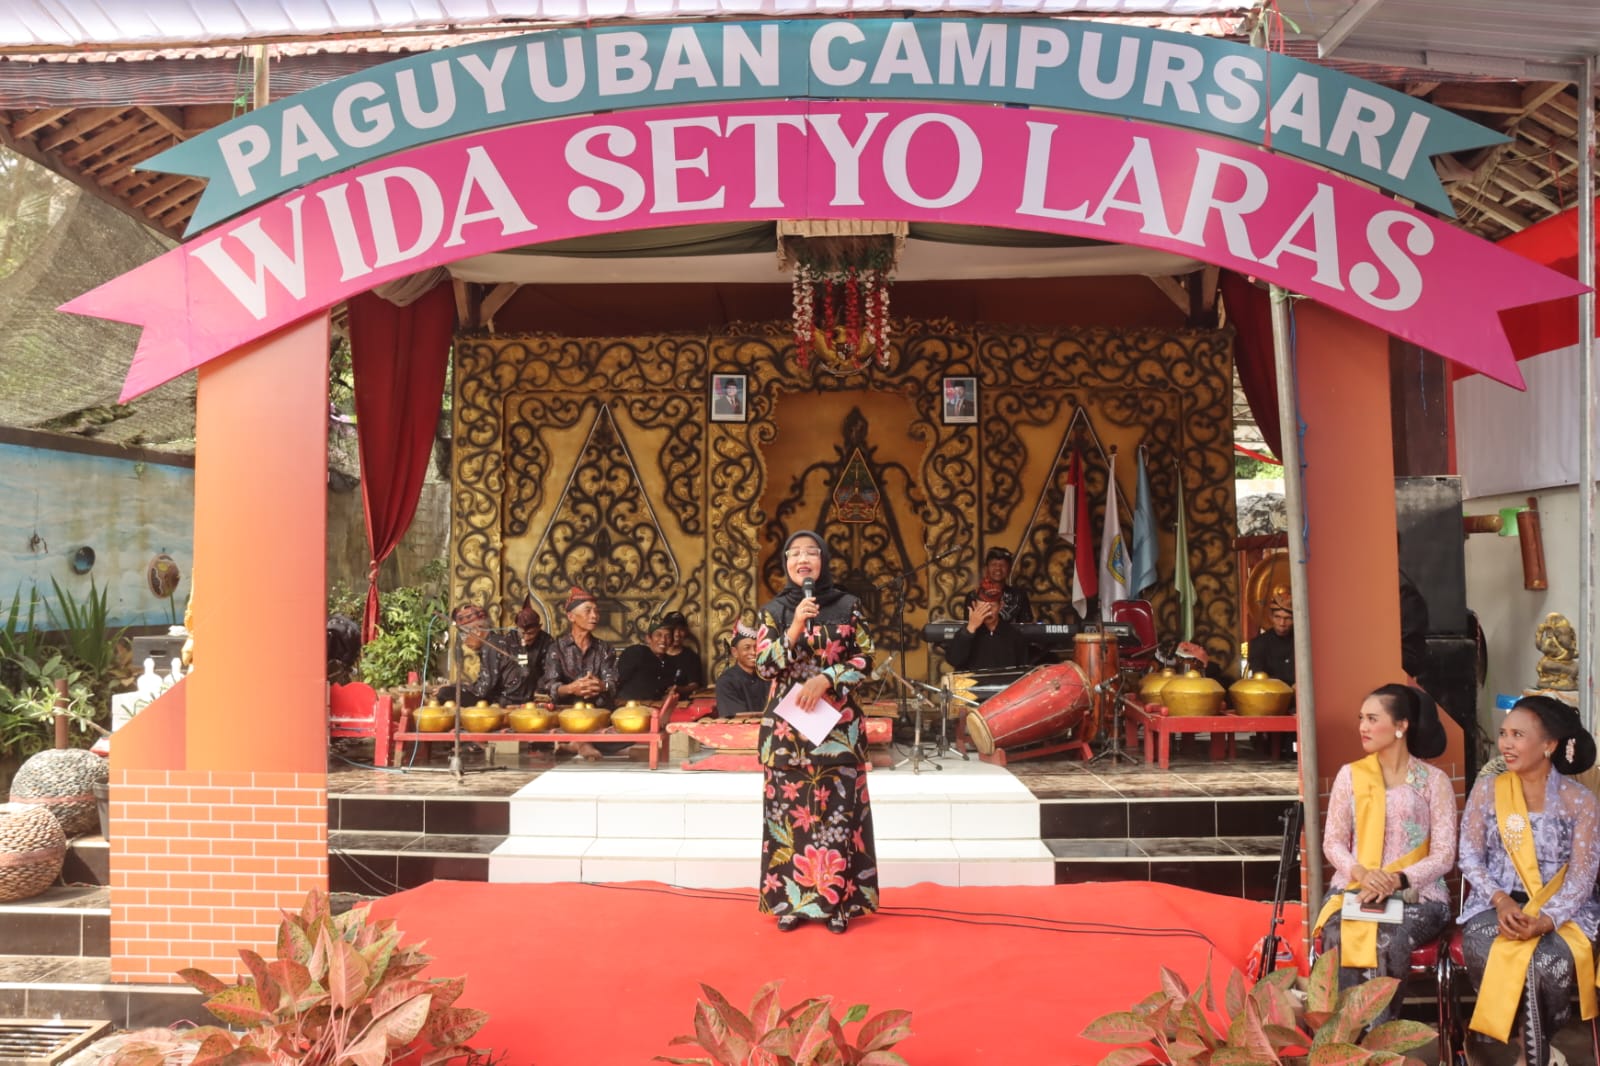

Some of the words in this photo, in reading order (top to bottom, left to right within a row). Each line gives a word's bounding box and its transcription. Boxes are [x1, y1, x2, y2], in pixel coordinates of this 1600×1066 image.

[217, 24, 780, 197] PAGUYUBAN
[809, 22, 1430, 181] CAMPURSARI
[190, 146, 537, 321] WIDA
[564, 112, 983, 221] SETYO
[1015, 121, 1434, 311] LARAS
[1046, 625, 1069, 633] KORG
